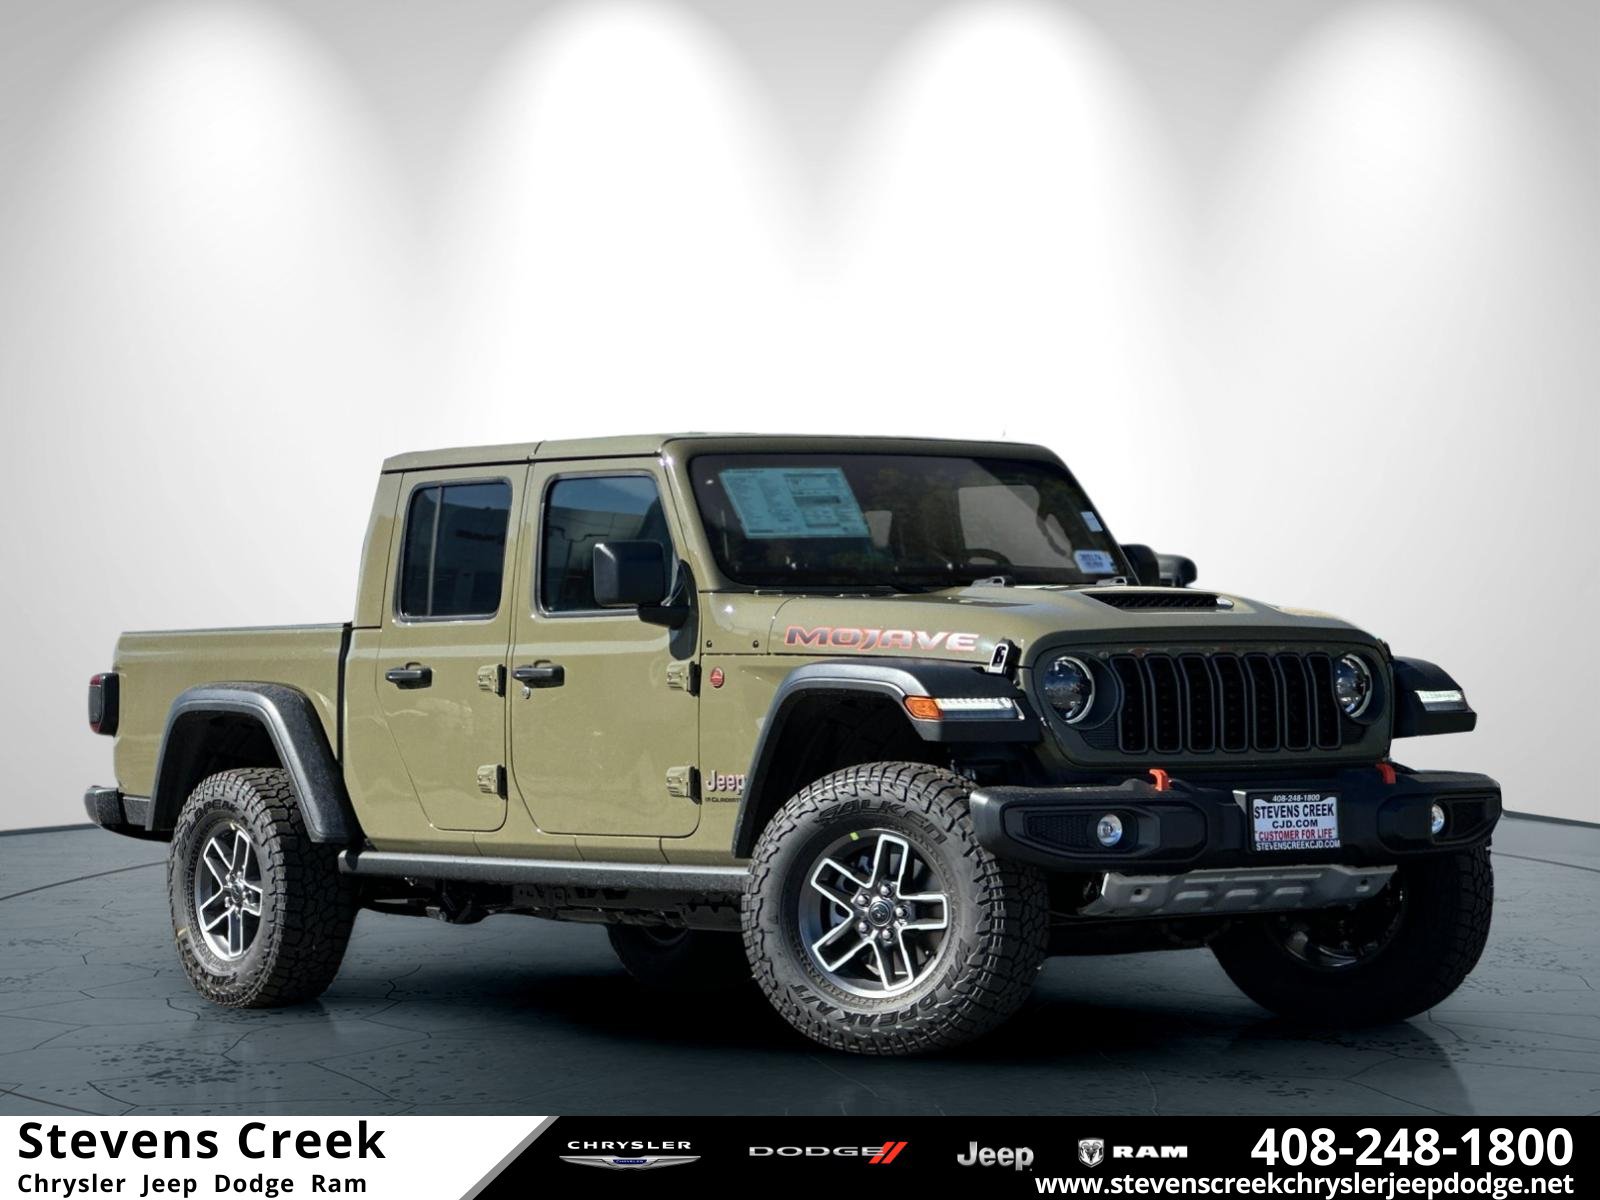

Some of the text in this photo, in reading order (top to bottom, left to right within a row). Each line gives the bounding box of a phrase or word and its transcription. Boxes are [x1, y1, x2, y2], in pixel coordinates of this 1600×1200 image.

[785, 625, 979, 651] MOJAVE
[705, 770, 746, 795] Jeep
[1272, 794, 1321, 803] 408-248-1800
[1254, 803, 1335, 820] STEVENS CREEK
[1272, 819, 1319, 829] CJD.COM
[1301, 829, 1316, 839] FOR
[1255, 839, 1341, 851] STEVENSCREEKCJD.COM
